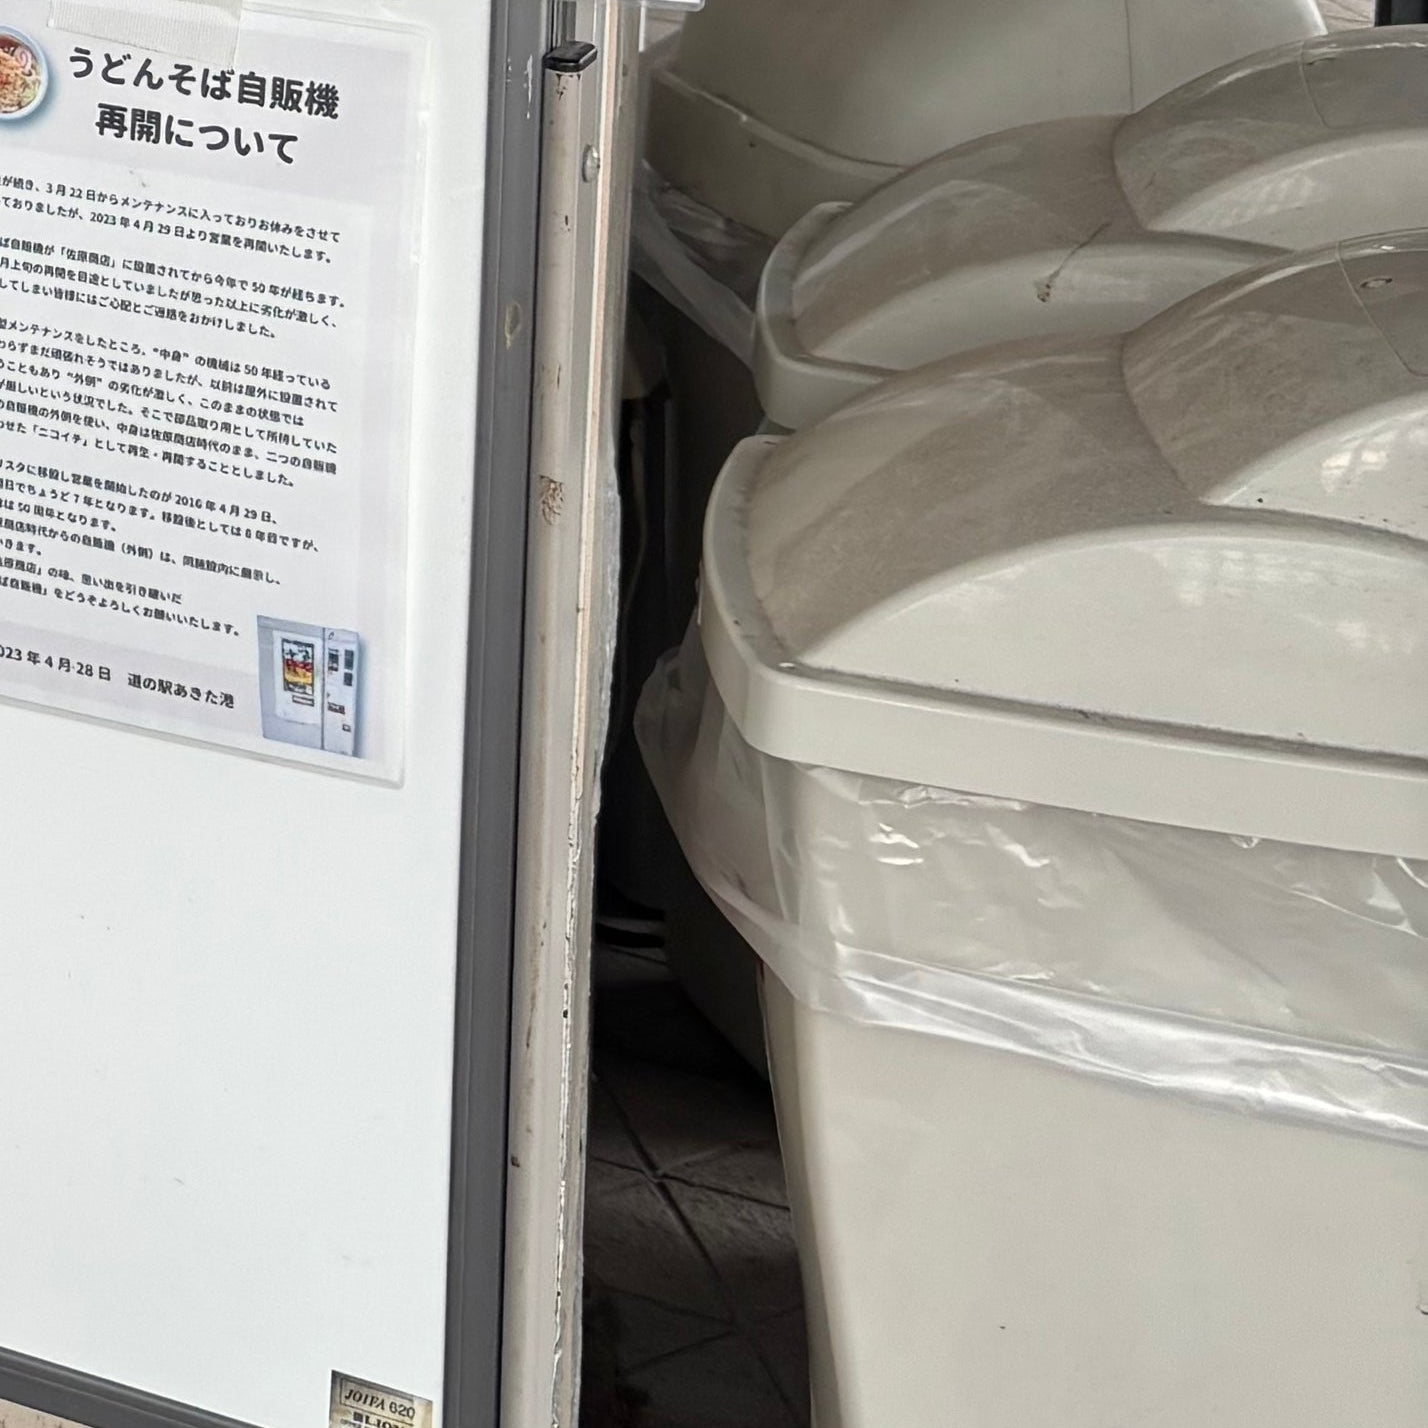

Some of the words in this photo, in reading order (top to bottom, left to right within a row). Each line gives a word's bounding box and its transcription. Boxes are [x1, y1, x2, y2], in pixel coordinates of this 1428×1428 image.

[68, 46, 340, 120] うどんそば自販機
[94, 101, 300, 165] 再開について
